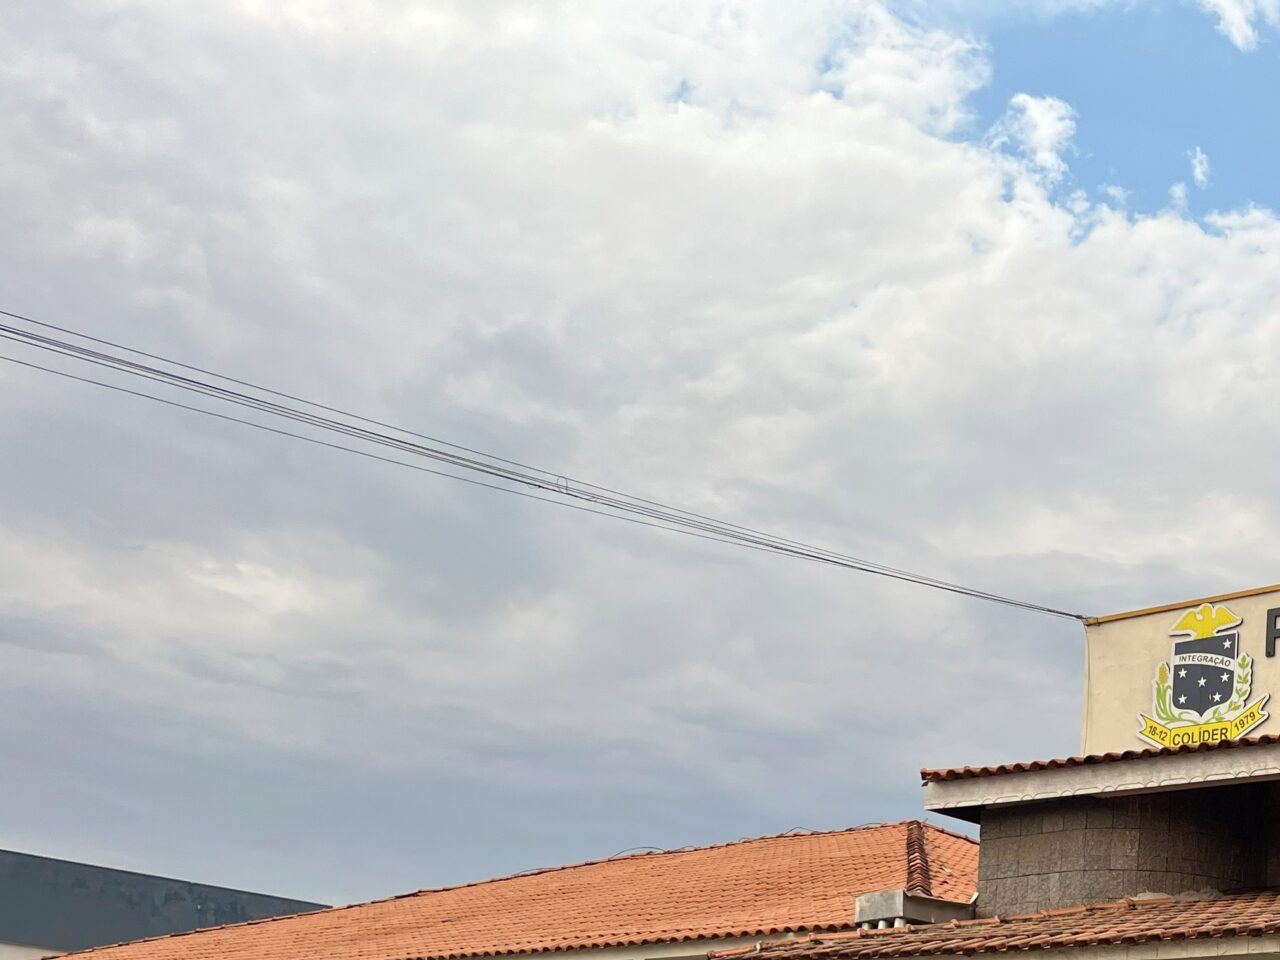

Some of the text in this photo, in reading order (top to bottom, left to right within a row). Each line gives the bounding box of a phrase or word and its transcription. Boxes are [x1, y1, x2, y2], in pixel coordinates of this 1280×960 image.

[1179, 654, 1231, 668] INTEGRAÇÃO
[1148, 711, 1256, 746] 18-12 COLÍDER 1979
